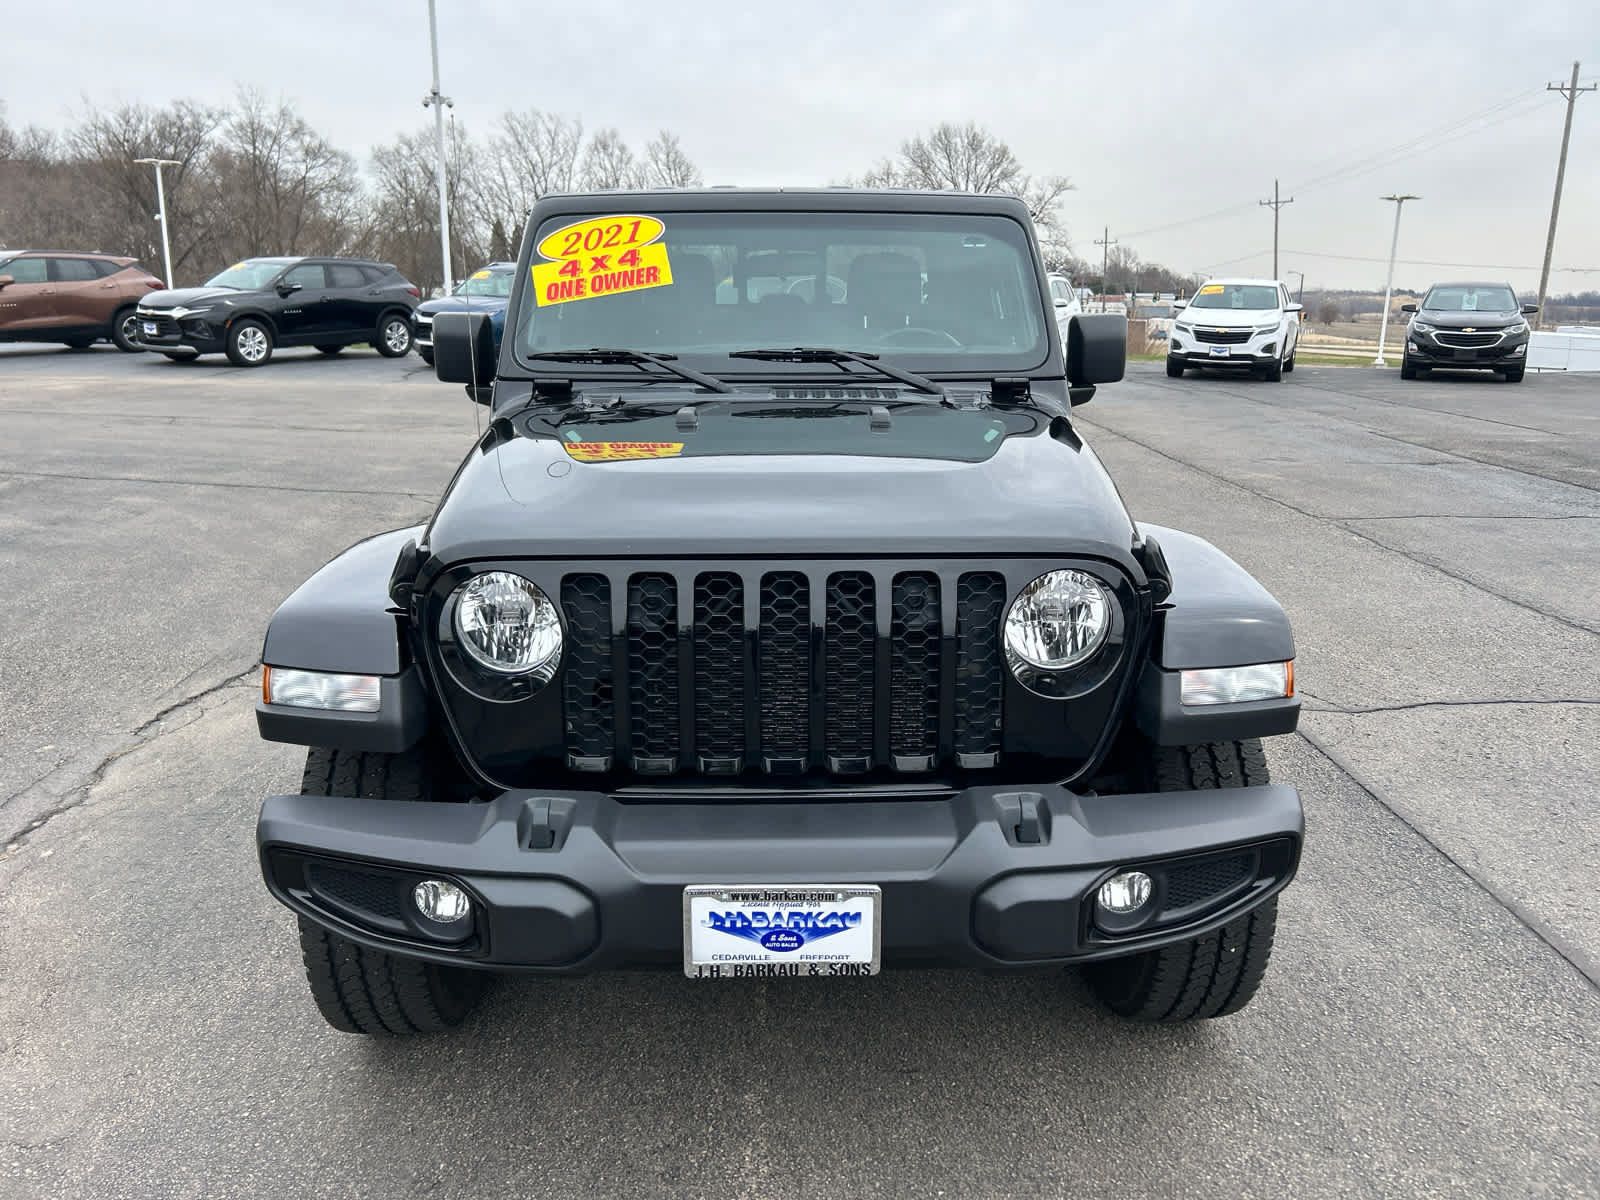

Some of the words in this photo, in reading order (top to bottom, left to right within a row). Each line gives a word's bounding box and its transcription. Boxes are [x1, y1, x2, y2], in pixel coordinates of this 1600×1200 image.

[561, 220, 642, 257] 2021
[546, 278, 587, 301] ONE
[591, 266, 659, 294] OWNER
[731, 890, 836, 901] www.barkau.com
[694, 964, 727, 978] J.H.
[734, 963, 799, 977] BARKAU
[808, 962, 820, 977] &
[829, 962, 872, 977] SONS
